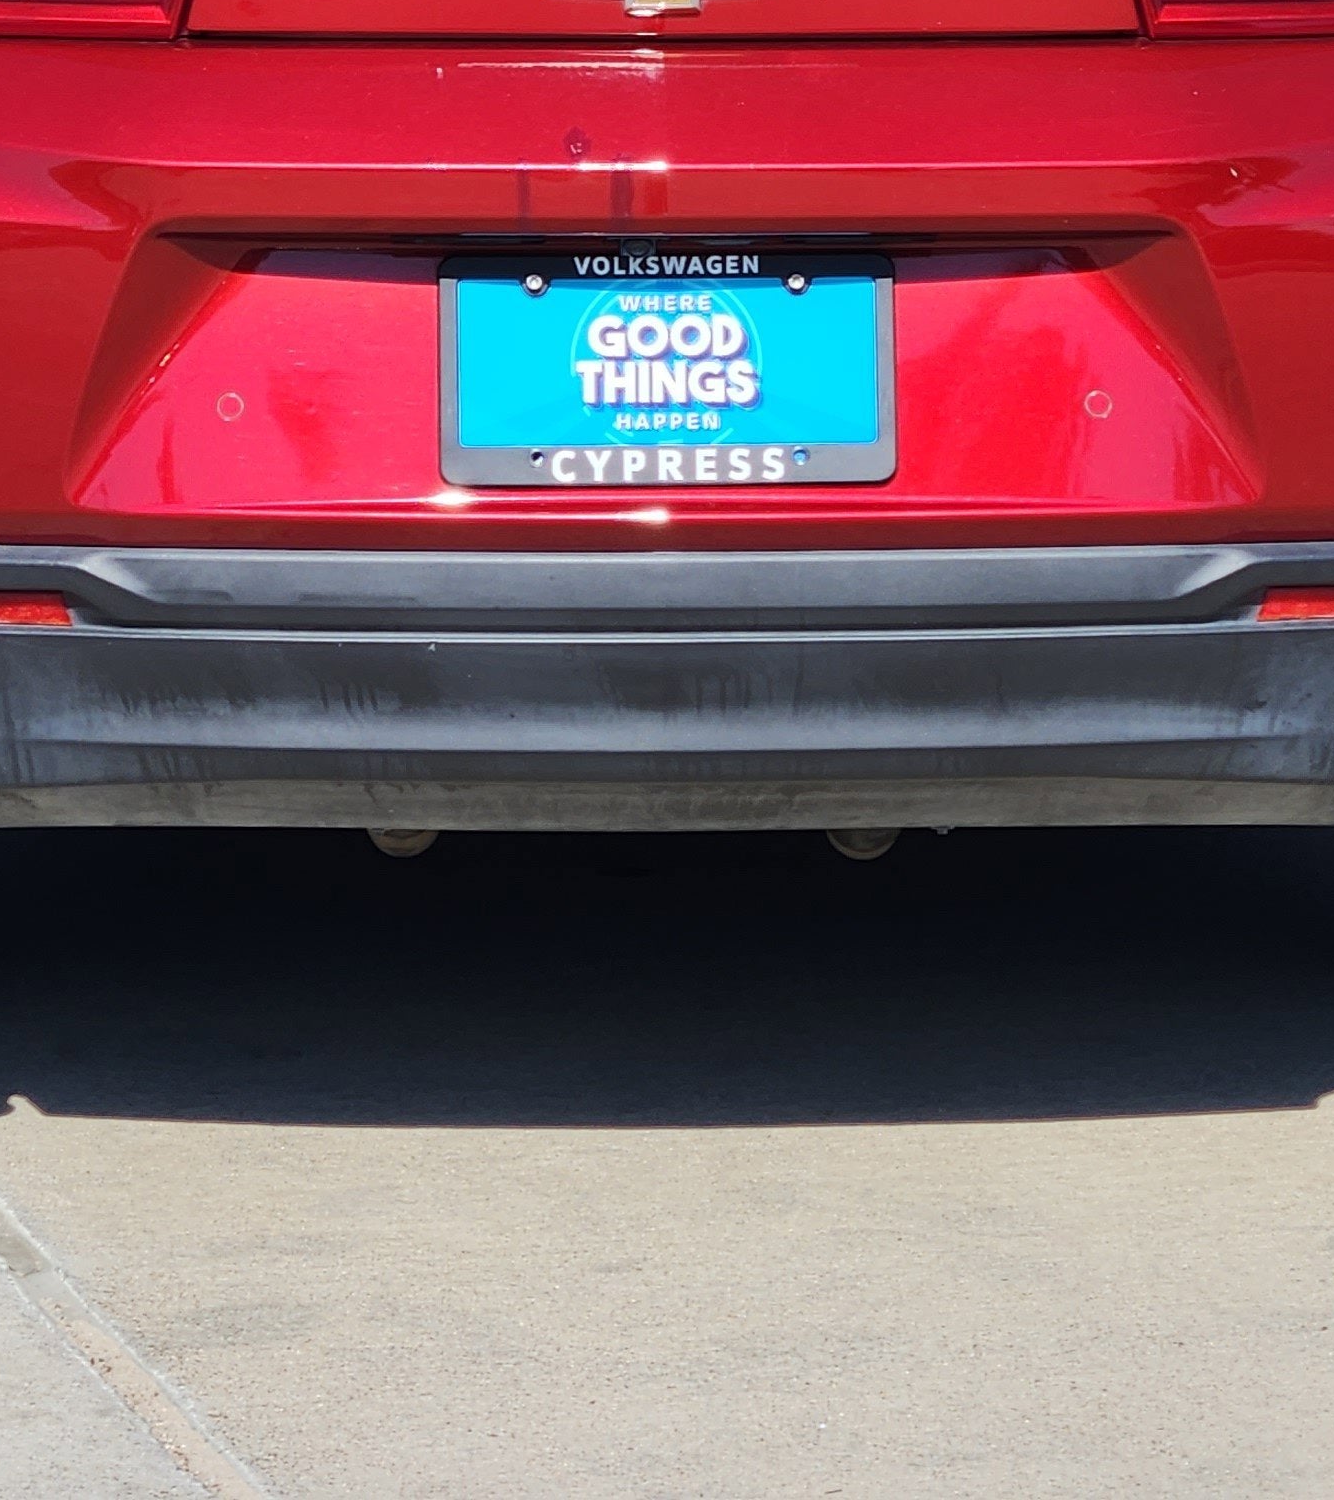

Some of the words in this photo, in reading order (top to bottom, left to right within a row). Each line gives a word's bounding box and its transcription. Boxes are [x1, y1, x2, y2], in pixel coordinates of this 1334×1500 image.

[573, 255, 760, 276] VOLKSWAGEN
[618, 294, 712, 312] WHERE
[587, 315, 747, 359] GOOD
[575, 359, 762, 409] THINGS
[615, 411, 722, 431] HAPPEN
[551, 448, 785, 483] CYPRESS
